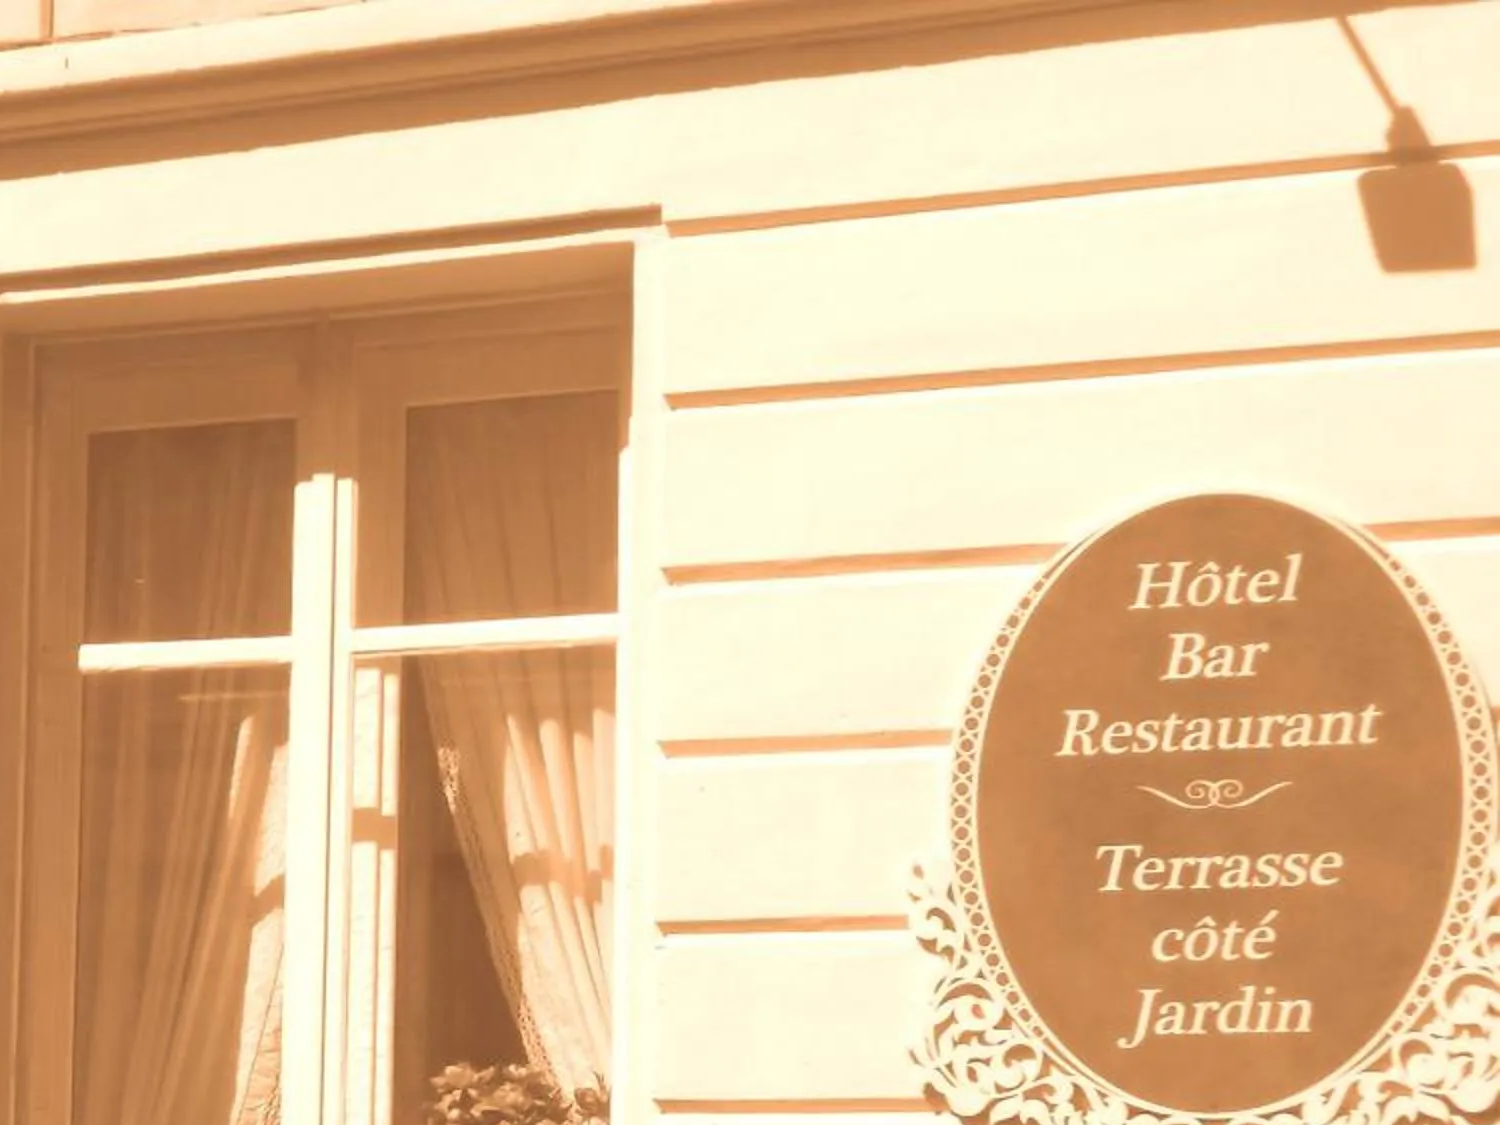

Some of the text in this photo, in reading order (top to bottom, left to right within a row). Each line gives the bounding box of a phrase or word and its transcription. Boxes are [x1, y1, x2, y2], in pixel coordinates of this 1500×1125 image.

[1128, 553, 1302, 610] Hôtel
[1160, 632, 1270, 681] Bar
[1055, 704, 1382, 757] Restaurant
[1096, 844, 1344, 892] Terrasse
[1151, 909, 1279, 963] côté
[1116, 985, 1312, 1049] Jardin
